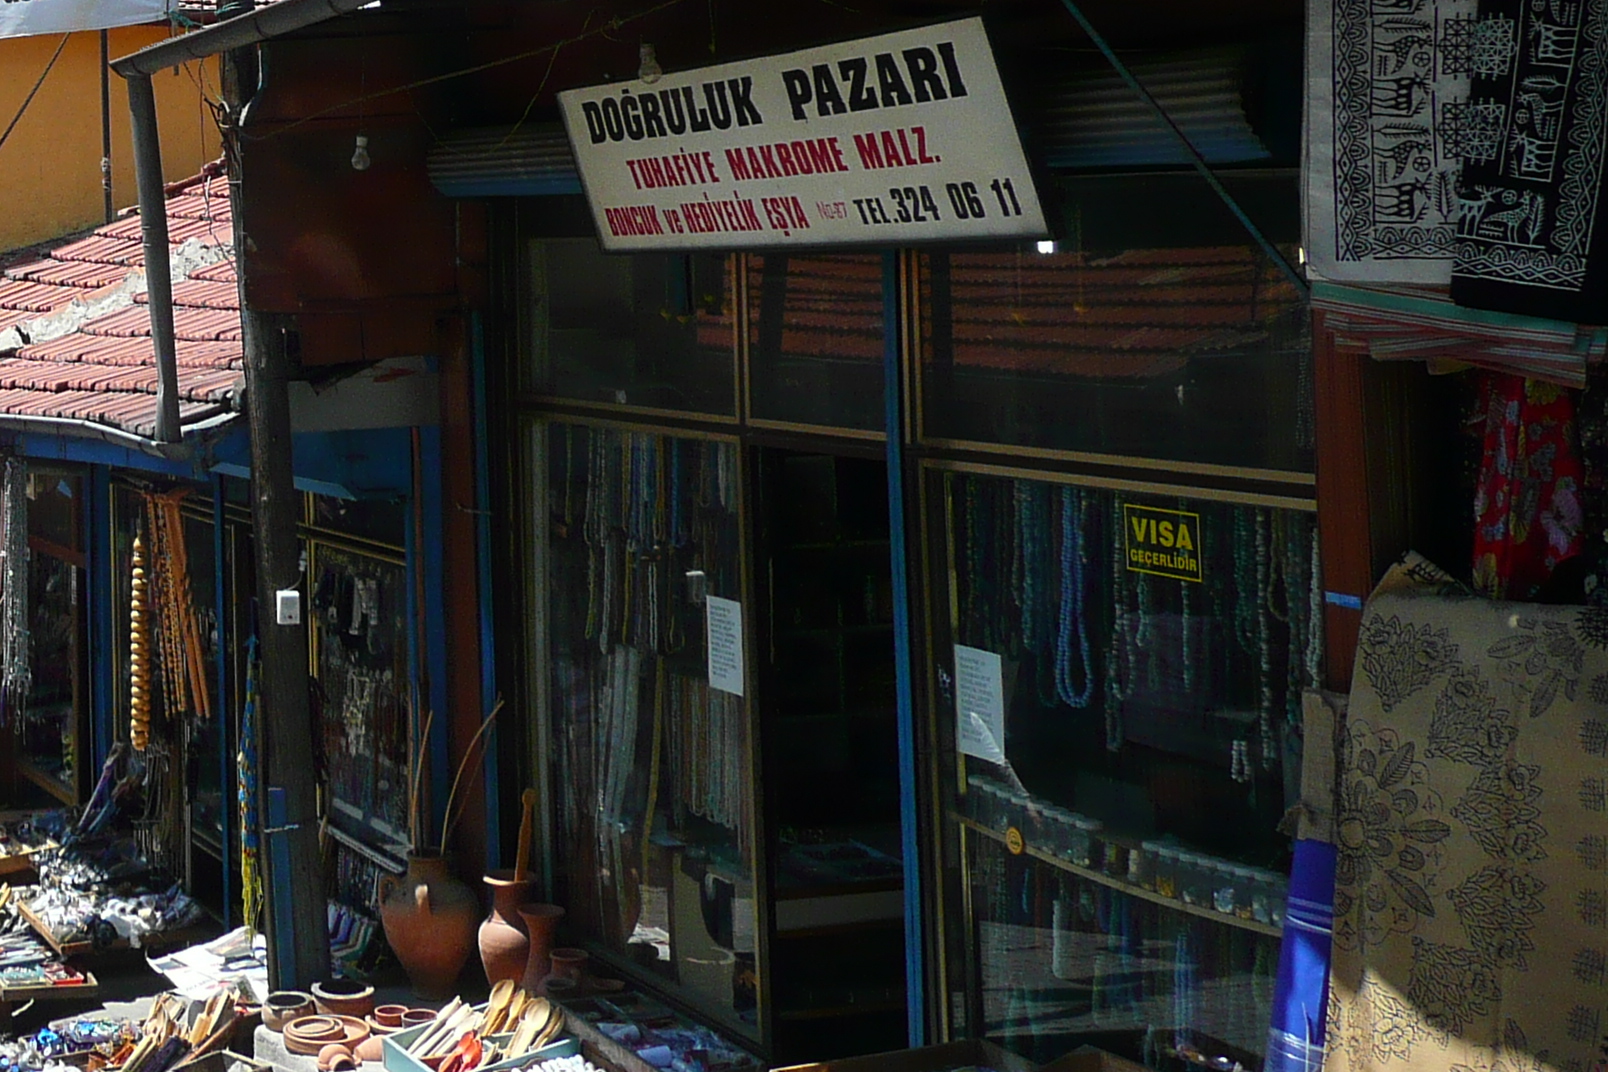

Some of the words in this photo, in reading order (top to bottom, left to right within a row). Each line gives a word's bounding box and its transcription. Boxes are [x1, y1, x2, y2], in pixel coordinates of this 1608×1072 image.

[582, 74, 763, 145] DOĞRULUK
[782, 41, 968, 121] PAZARI
[626, 148, 720, 190] TUHAFİYE
[727, 136, 849, 182] MAKROME
[853, 125, 942, 170] MALZ.
[604, 204, 664, 237] BONCUK
[662, 208, 685, 234] ve
[679, 190, 763, 234] HEDİYELİK
[760, 195, 811, 237] EŞYA
[947, 181, 983, 219] 06
[991, 177, 1022, 216] 11
[1132, 516, 1193, 551] VISA
[1130, 548, 1198, 572] GEÇERLİDİR
